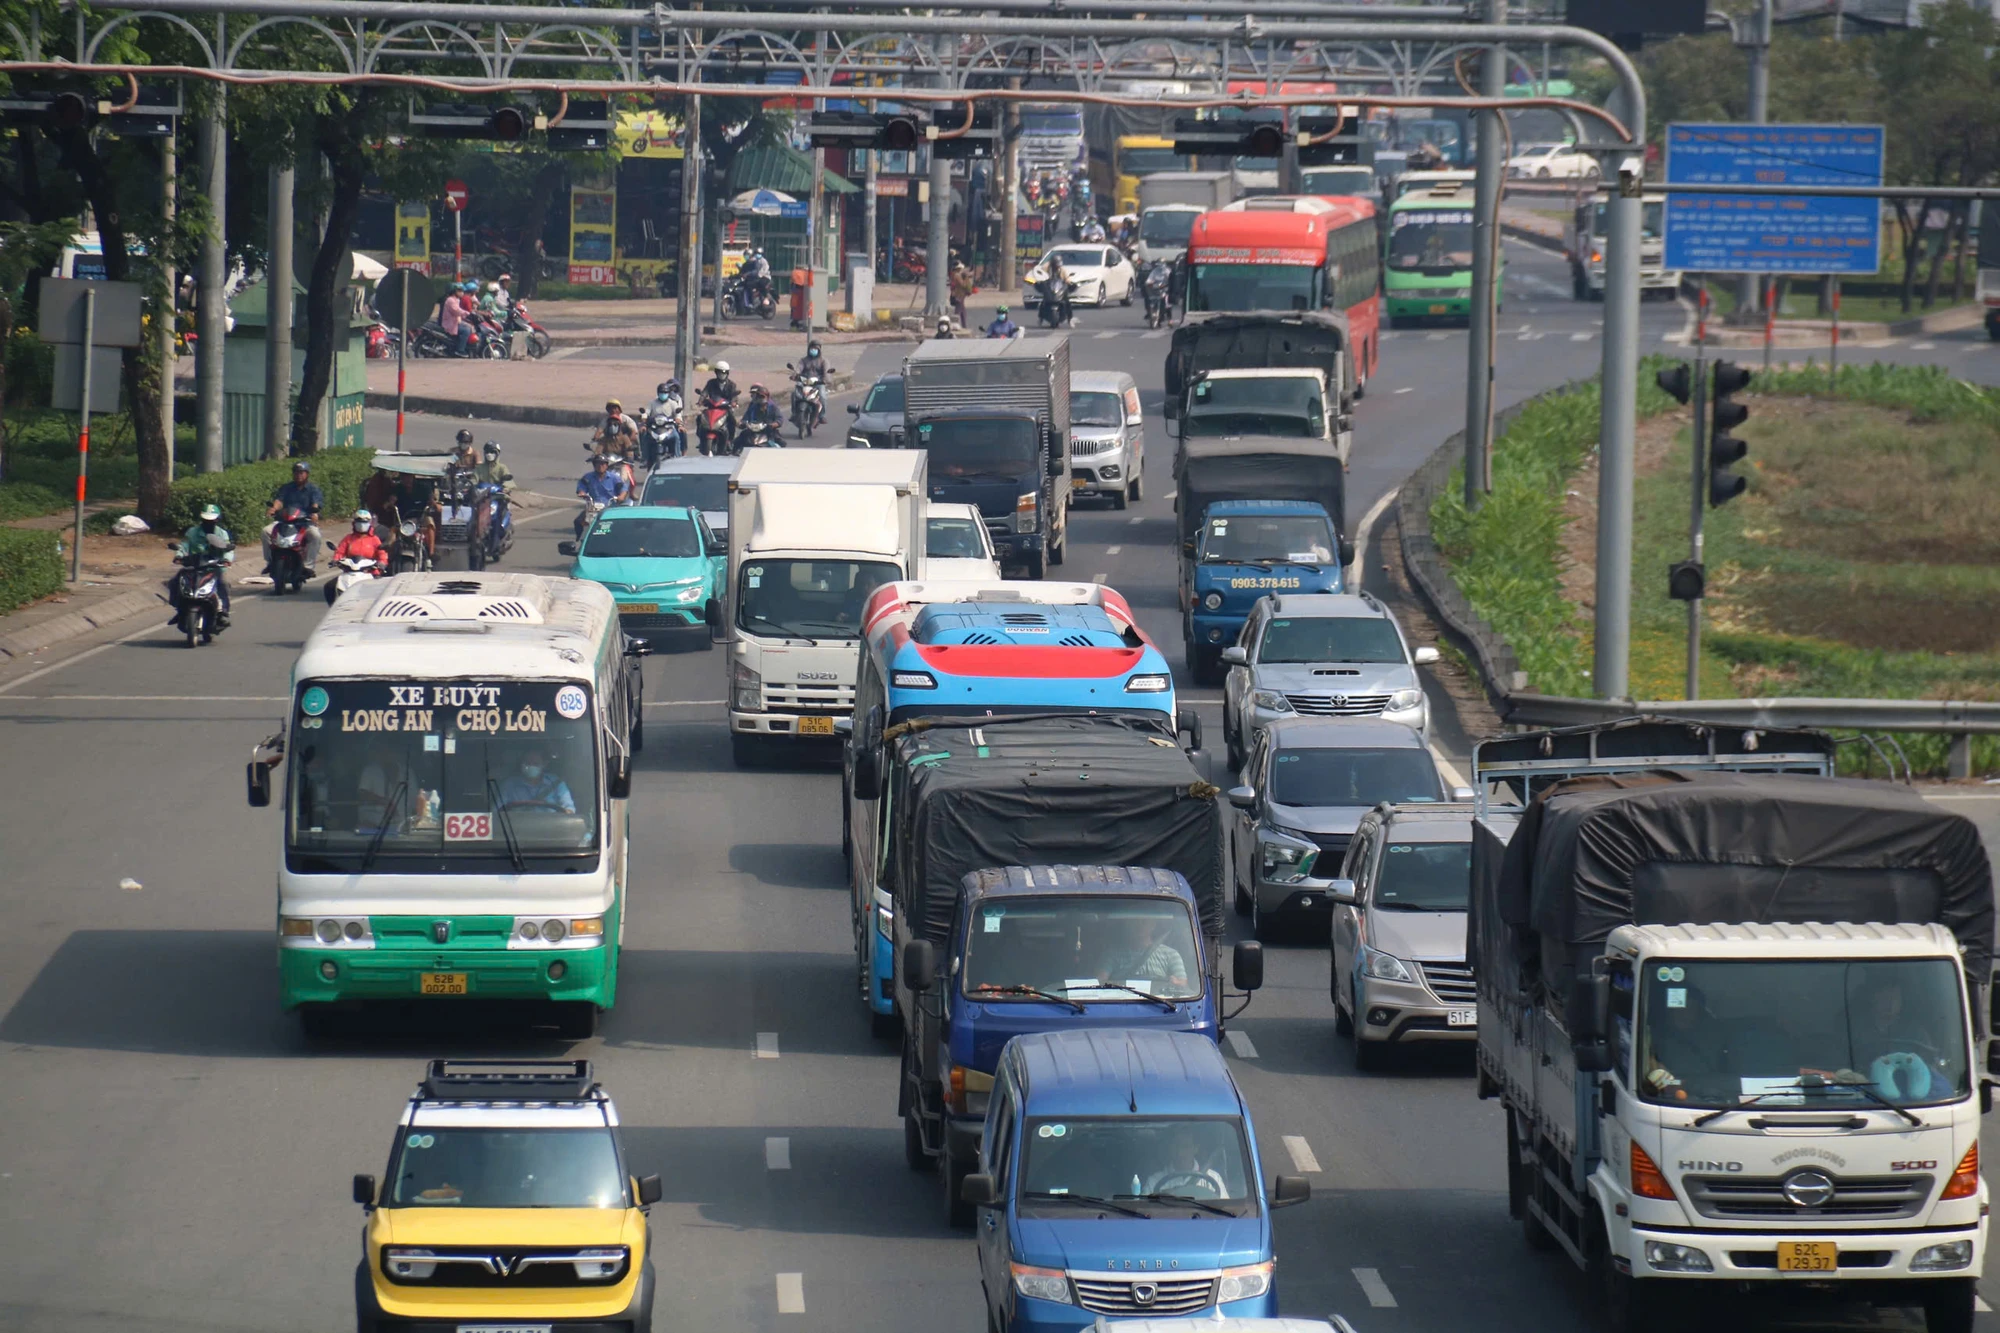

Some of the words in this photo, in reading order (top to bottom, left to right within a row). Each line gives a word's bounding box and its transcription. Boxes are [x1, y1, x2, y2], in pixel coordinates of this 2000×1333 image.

[1231, 577, 1300, 589] 0903.378.615
[797, 672, 838, 680] ISUZU
[389, 686, 424, 706] XE
[432, 683, 500, 706] BUÝT
[560, 693, 583, 712] 628
[341, 709, 399, 732] LONG
[403, 709, 433, 732] AN
[456, 707, 501, 735] CHỢ
[505, 704, 547, 732] LỚN
[446, 815, 490, 838] 628
[434, 974, 454, 984] 62B
[1678, 1160, 1743, 1172] HINO
[1891, 1160, 1937, 1171] 500
[1794, 1243, 1819, 1256] 62C
[1107, 1259, 1179, 1269] KENBO
[1785, 1257, 1830, 1270] 129.37
